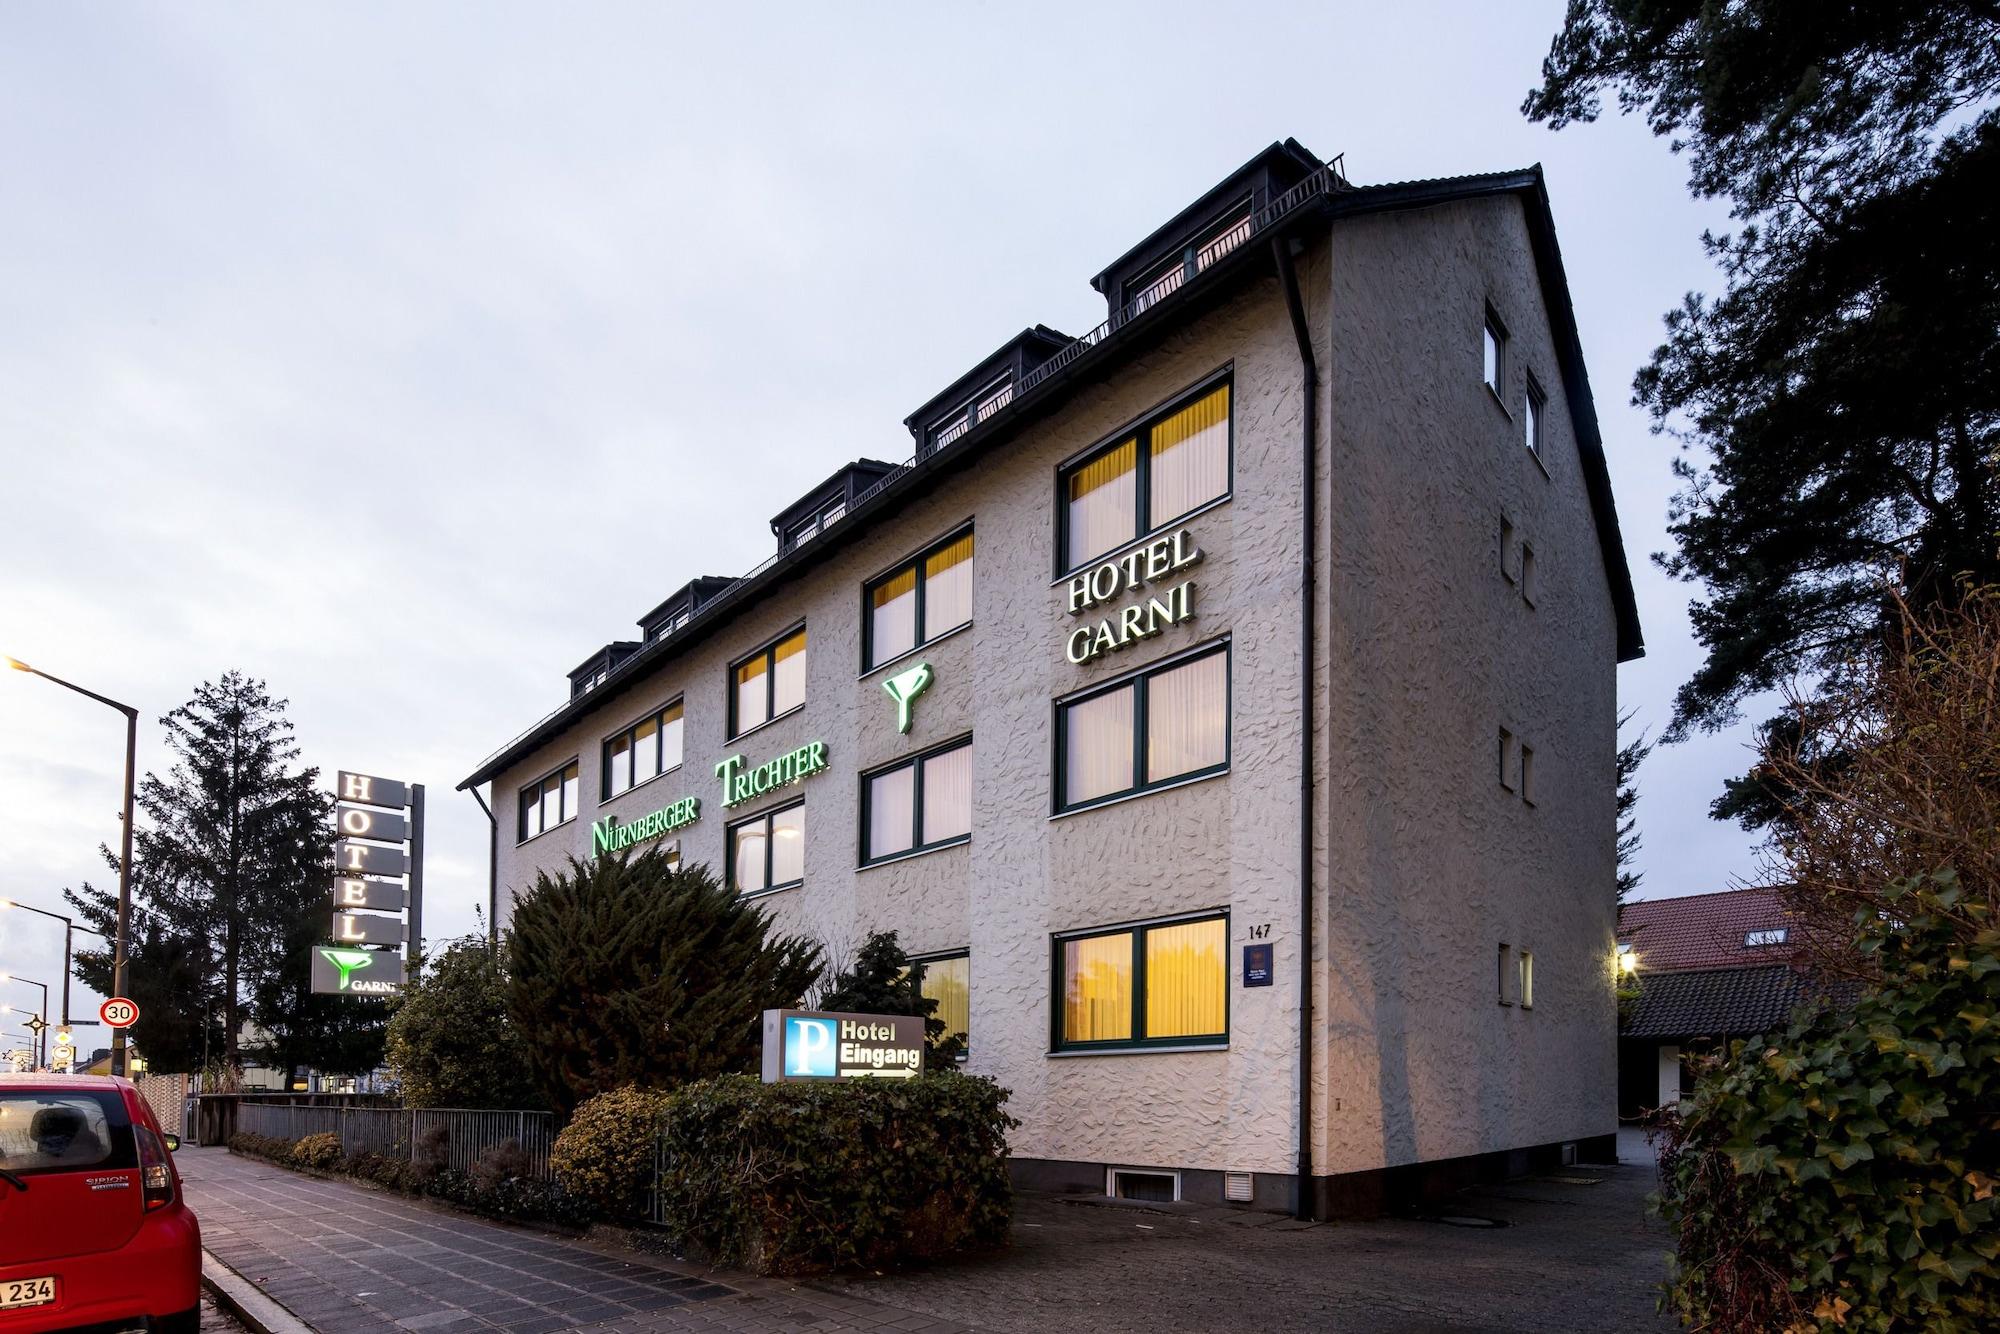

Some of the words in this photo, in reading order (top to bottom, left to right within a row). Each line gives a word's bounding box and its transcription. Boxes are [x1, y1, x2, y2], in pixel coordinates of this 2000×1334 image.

[1067, 529, 1203, 614] HOTEL
[1066, 581, 1194, 664] GARNI
[591, 796, 699, 859] NÜRNBERGER
[715, 740, 827, 807] TRICHTER
[342, 774, 371, 940] HOTEL
[1248, 923, 1271, 939] 147
[108, 1006, 130, 1020] 30
[841, 1020, 896, 1041] Hotel
[792, 1020, 829, 1074] P
[840, 1043, 920, 1069] Eingang
